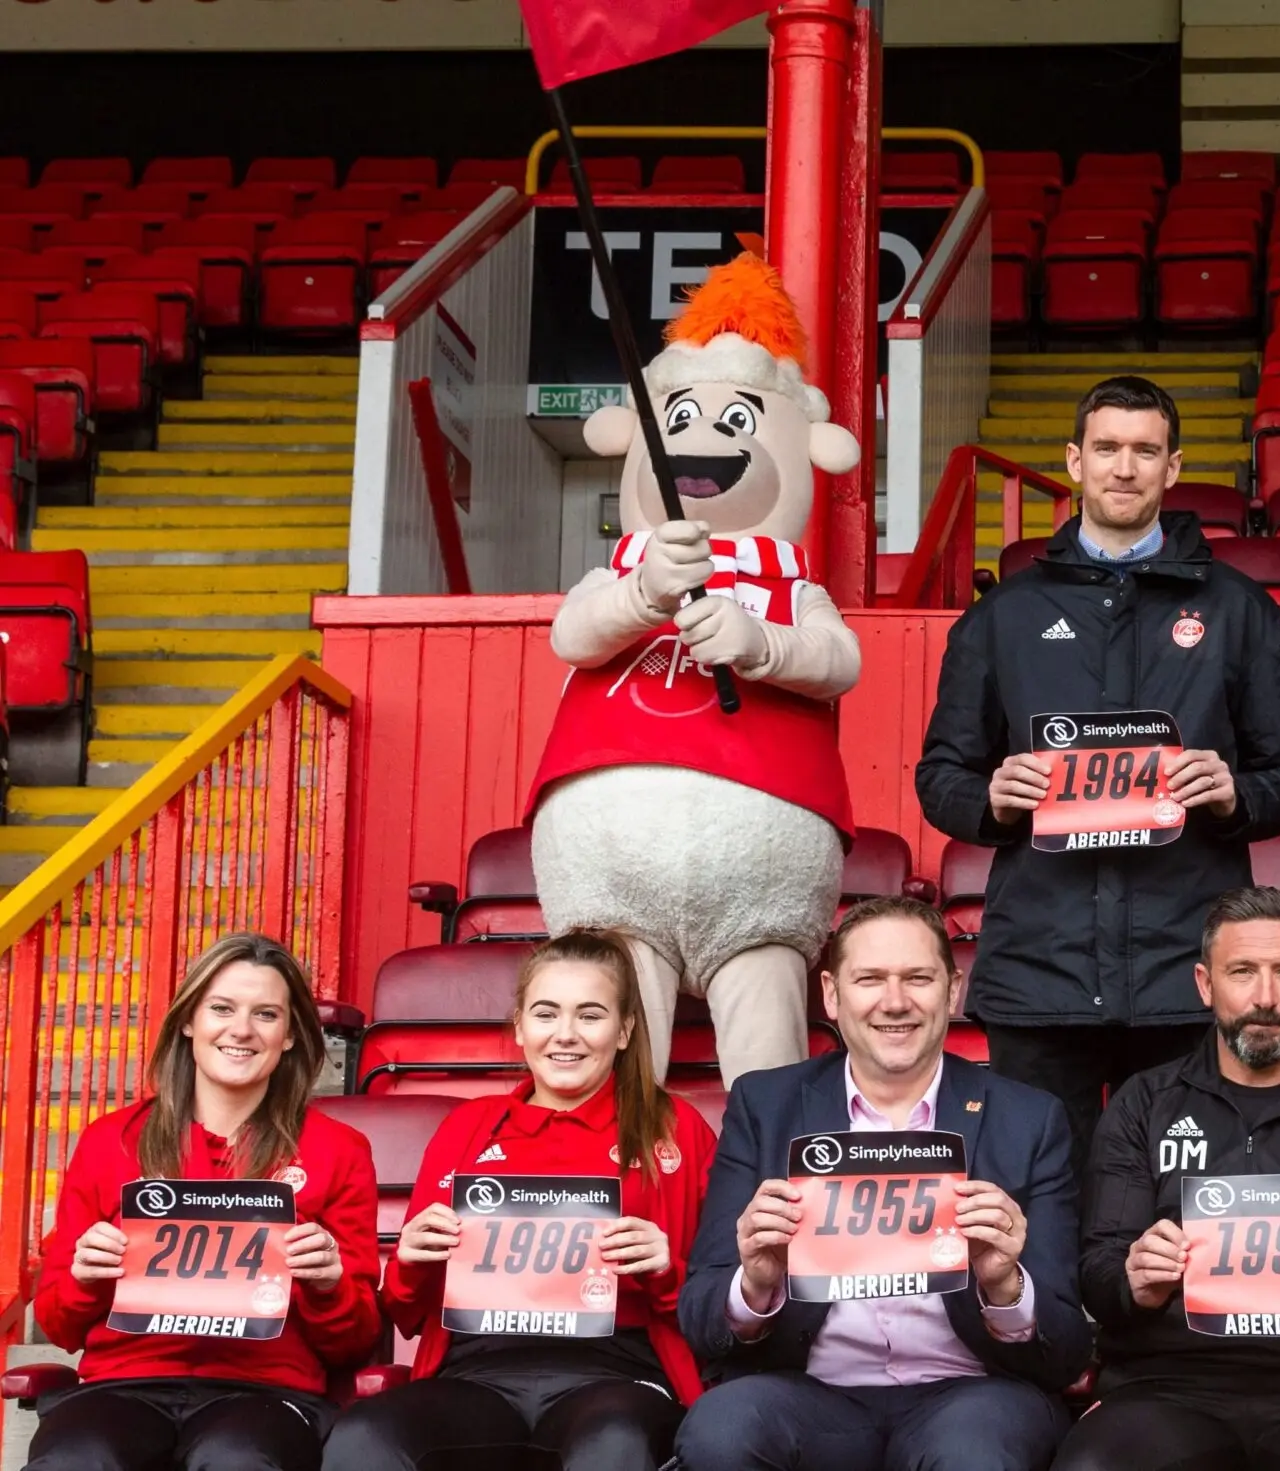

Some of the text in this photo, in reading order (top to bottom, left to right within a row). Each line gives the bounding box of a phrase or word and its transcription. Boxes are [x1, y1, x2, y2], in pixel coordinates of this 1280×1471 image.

[540, 392, 578, 408] EXIT
[1041, 631, 1076, 640] adidas
[1083, 723, 1170, 738] Simplyhealth
[1056, 751, 1161, 801] 1984
[1066, 829, 1151, 850] ABERDEEN
[1167, 1128, 1204, 1137] adidas
[849, 1145, 953, 1161] Simplyhealth
[1159, 1140, 1208, 1173] DM
[182, 1193, 284, 1209] Simplyhealth
[511, 1189, 610, 1205] Simplyhealth
[814, 1179, 941, 1236] 1955
[145, 1224, 270, 1280] 2014
[472, 1221, 595, 1274] 1986
[828, 1272, 928, 1300] ABERDEEN
[146, 1314, 247, 1337] ABERDEEN
[479, 1310, 577, 1335] ABERDEEN
